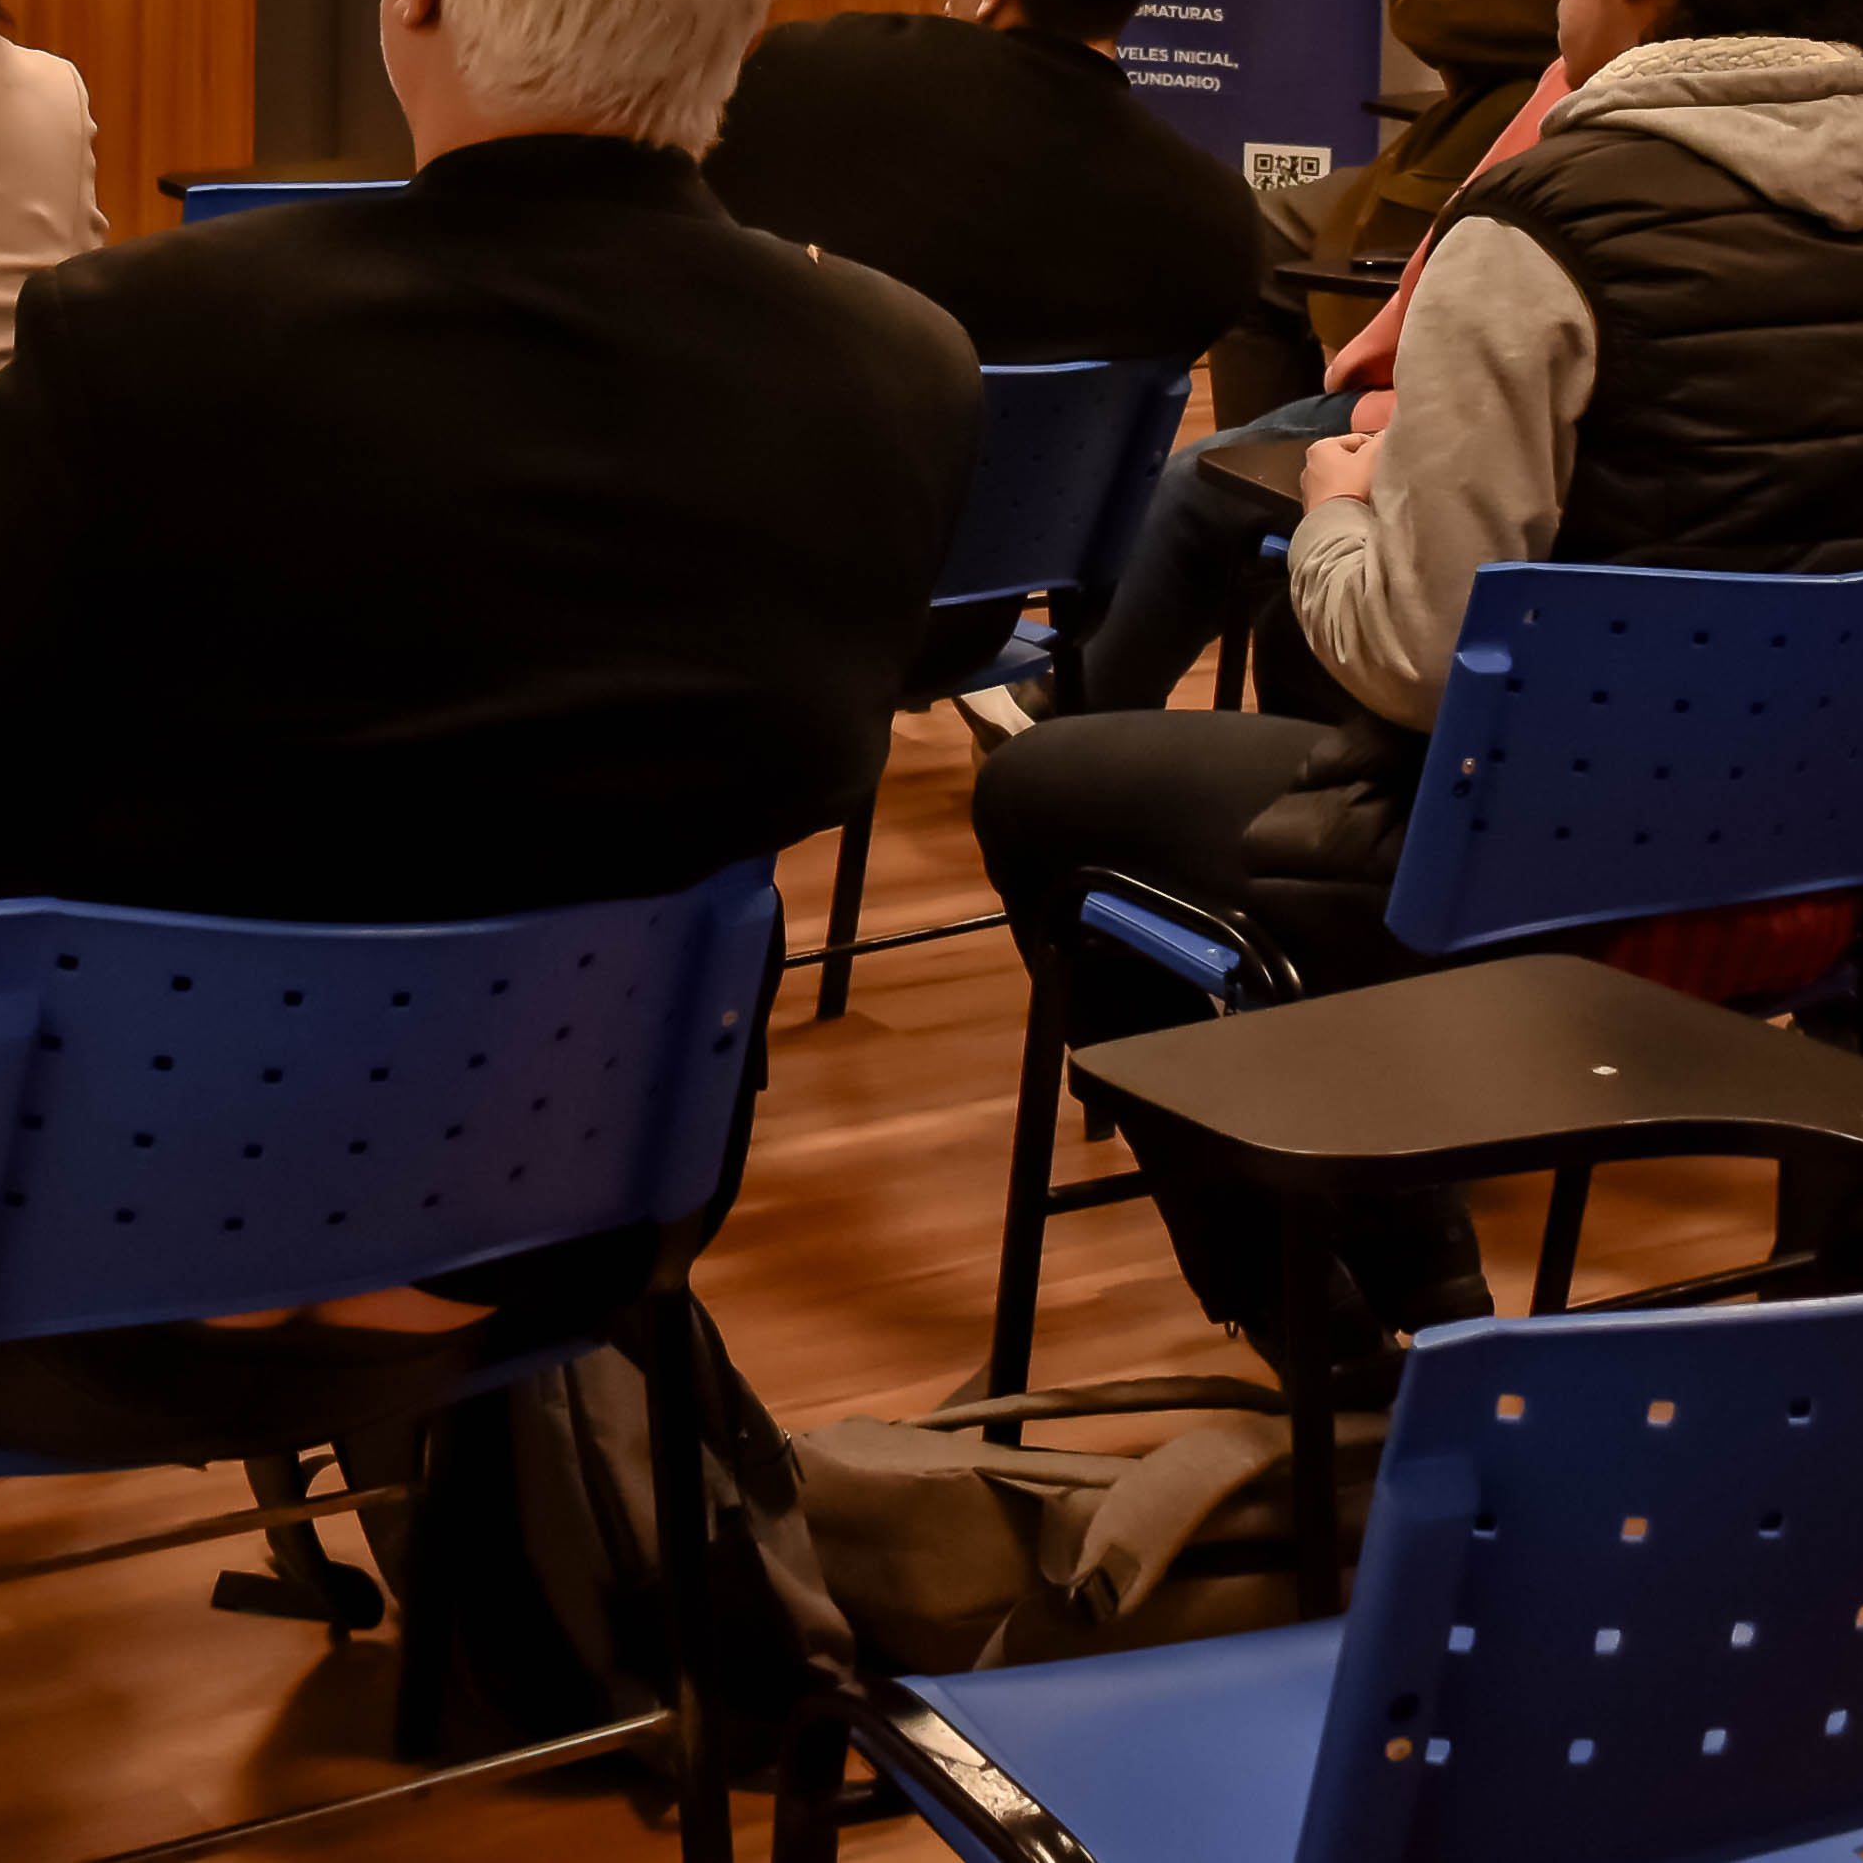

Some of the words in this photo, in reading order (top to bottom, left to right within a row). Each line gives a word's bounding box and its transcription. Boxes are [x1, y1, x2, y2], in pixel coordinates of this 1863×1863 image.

[1116, 45, 1169, 63] VELES
[1173, 49, 1239, 69] INICIAL,
[1126, 71, 1221, 92] CUNDARIO)
